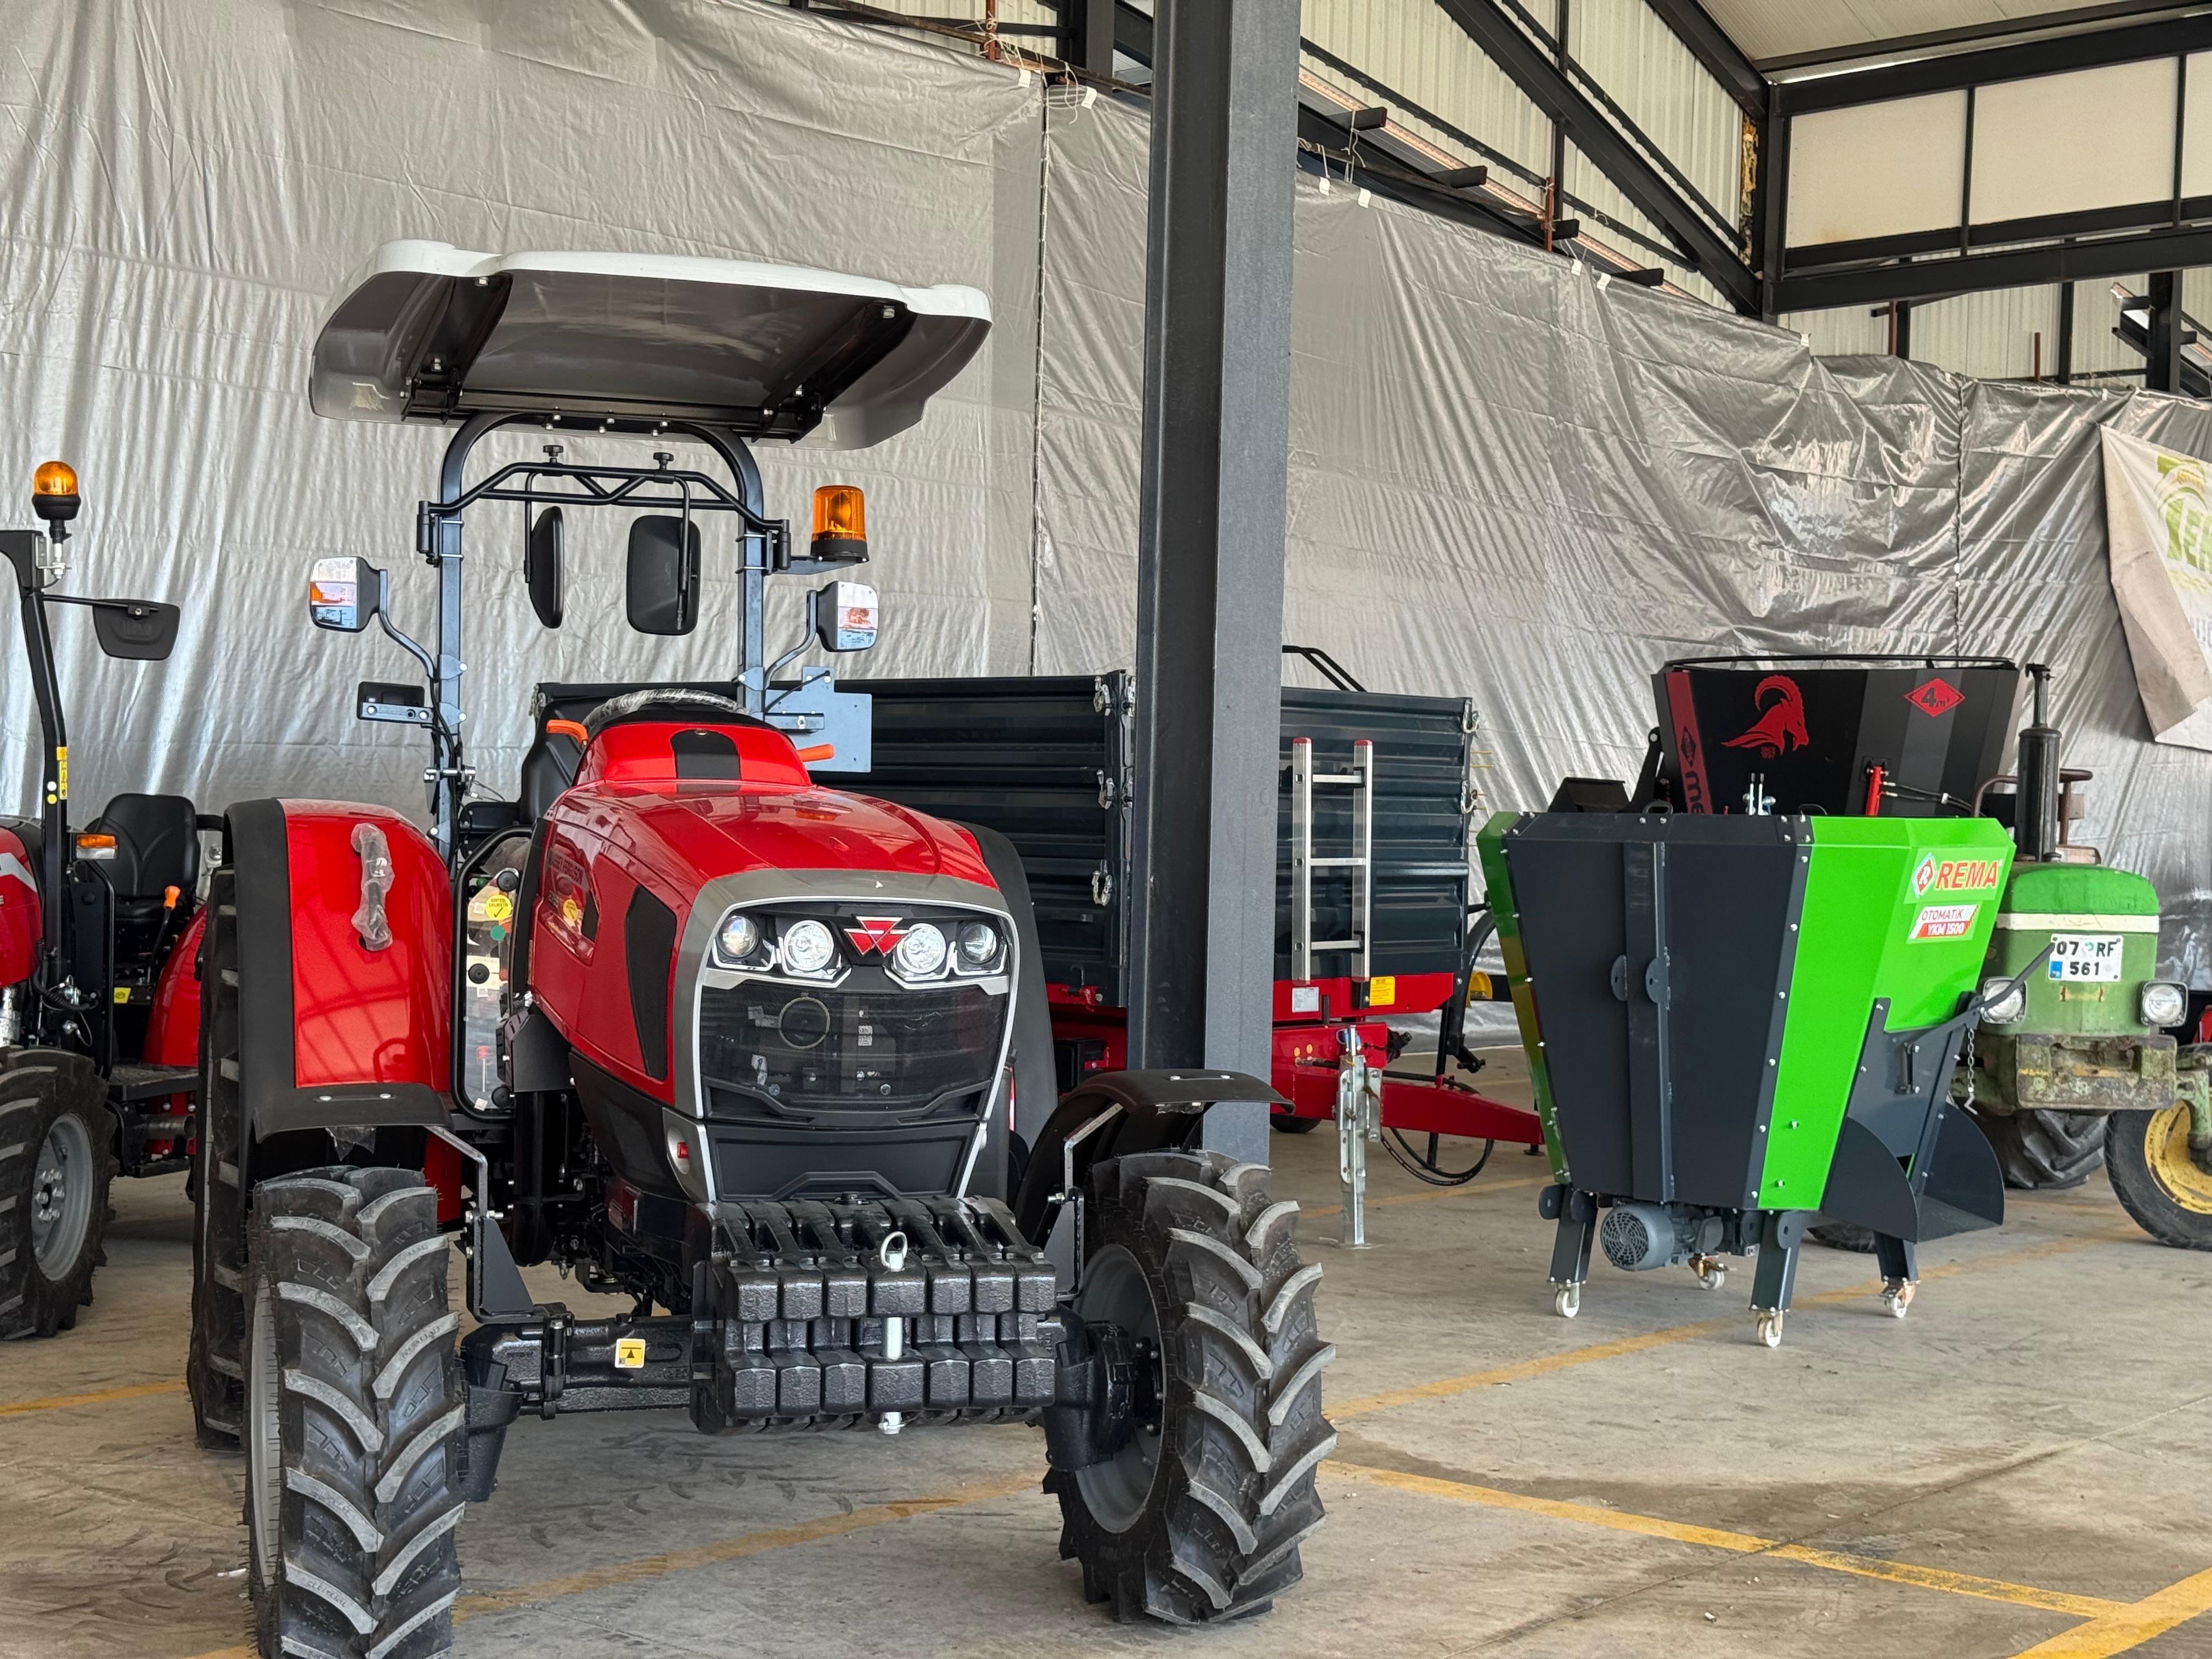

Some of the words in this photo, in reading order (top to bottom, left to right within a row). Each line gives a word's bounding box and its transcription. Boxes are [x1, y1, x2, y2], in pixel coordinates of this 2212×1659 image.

[1934, 861, 1998, 889] REMA
[2056, 940, 2079, 956] 07
[2069, 961, 2100, 976] 561
